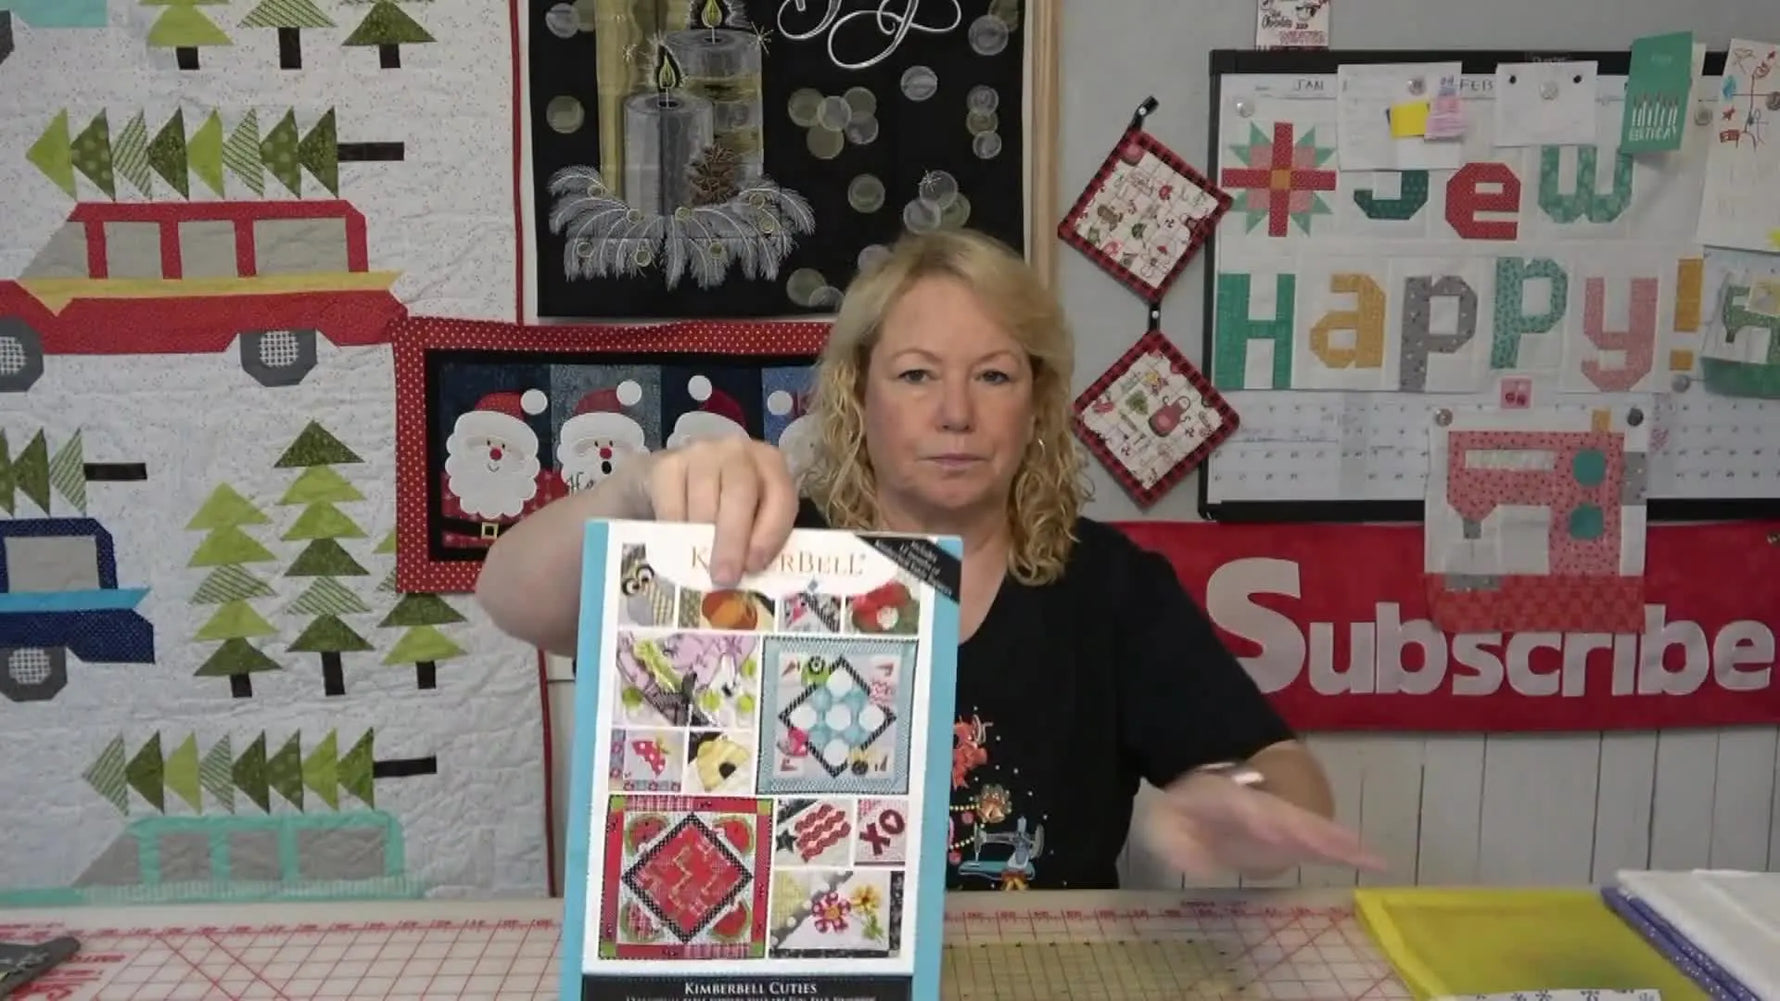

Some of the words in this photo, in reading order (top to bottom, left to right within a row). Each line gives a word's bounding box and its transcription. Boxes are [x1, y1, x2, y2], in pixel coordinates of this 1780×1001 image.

[1294, 79, 1324, 91] JAN
[1460, 78, 1494, 92] FEB
[1214, 257, 1704, 392] Happy!
[1206, 557, 1775, 697] Subscribe
[769, 981, 818, 995] CUTIES
